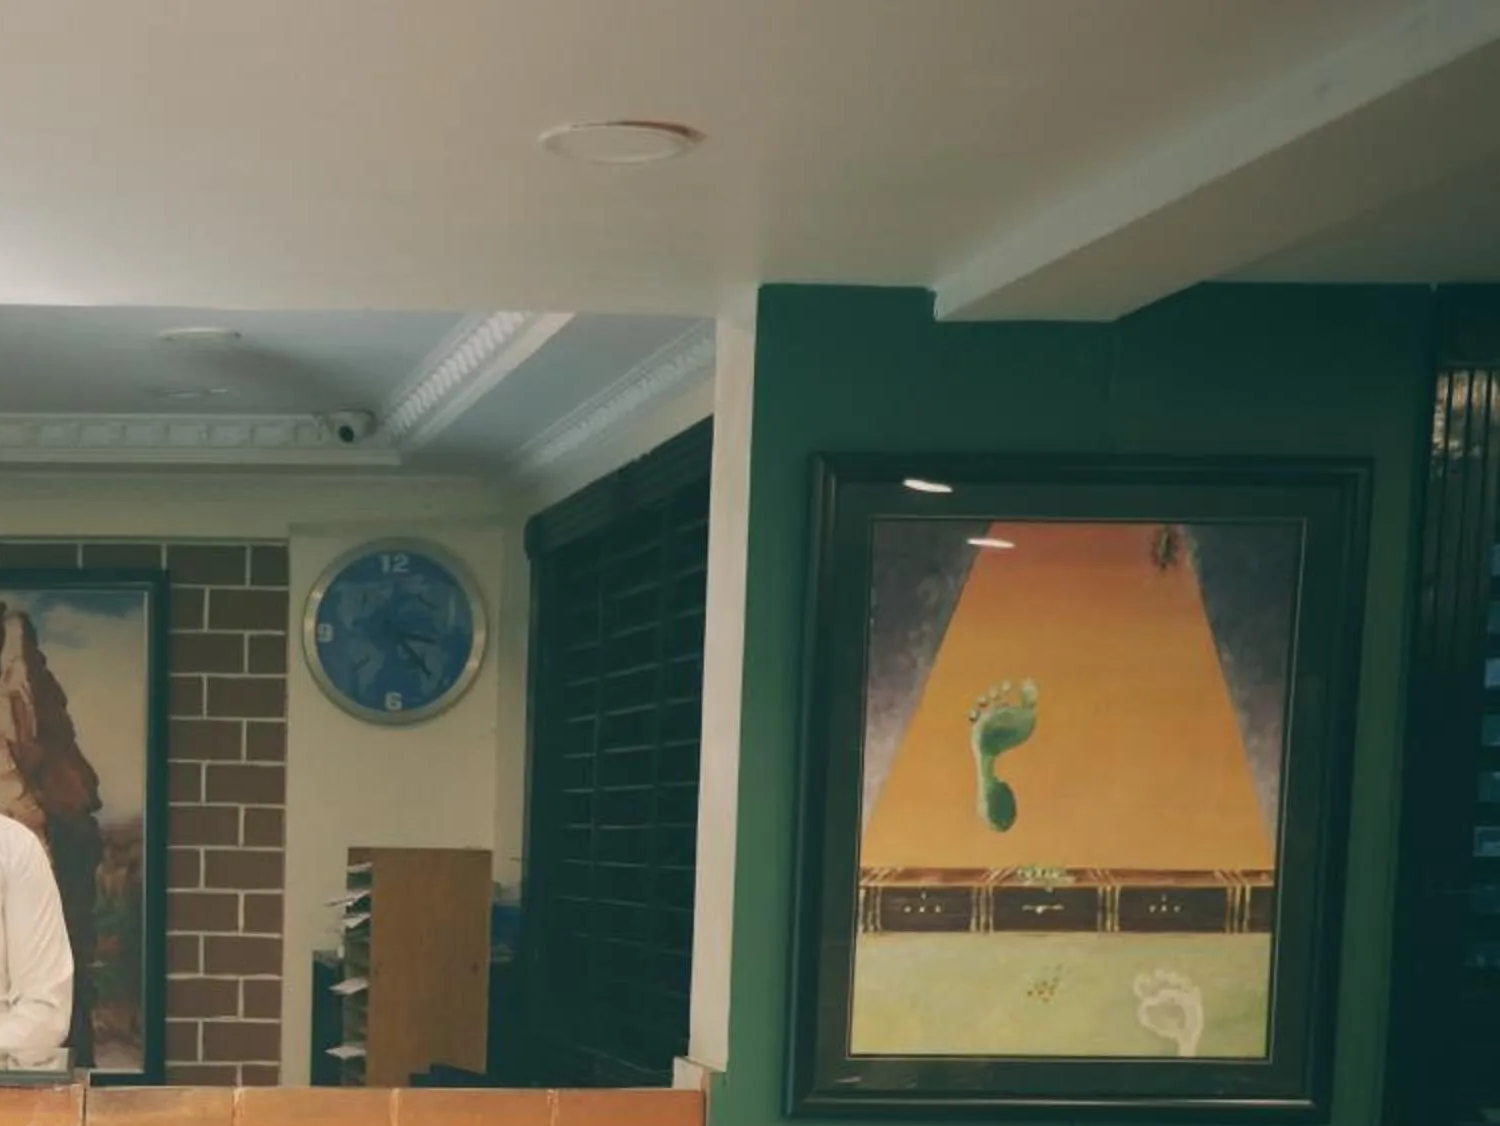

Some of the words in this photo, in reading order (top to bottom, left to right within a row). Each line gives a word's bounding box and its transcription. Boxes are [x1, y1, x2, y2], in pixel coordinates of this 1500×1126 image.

[380, 553, 409, 574] 12
[317, 623, 334, 643] 9
[385, 691, 402, 711] 6
